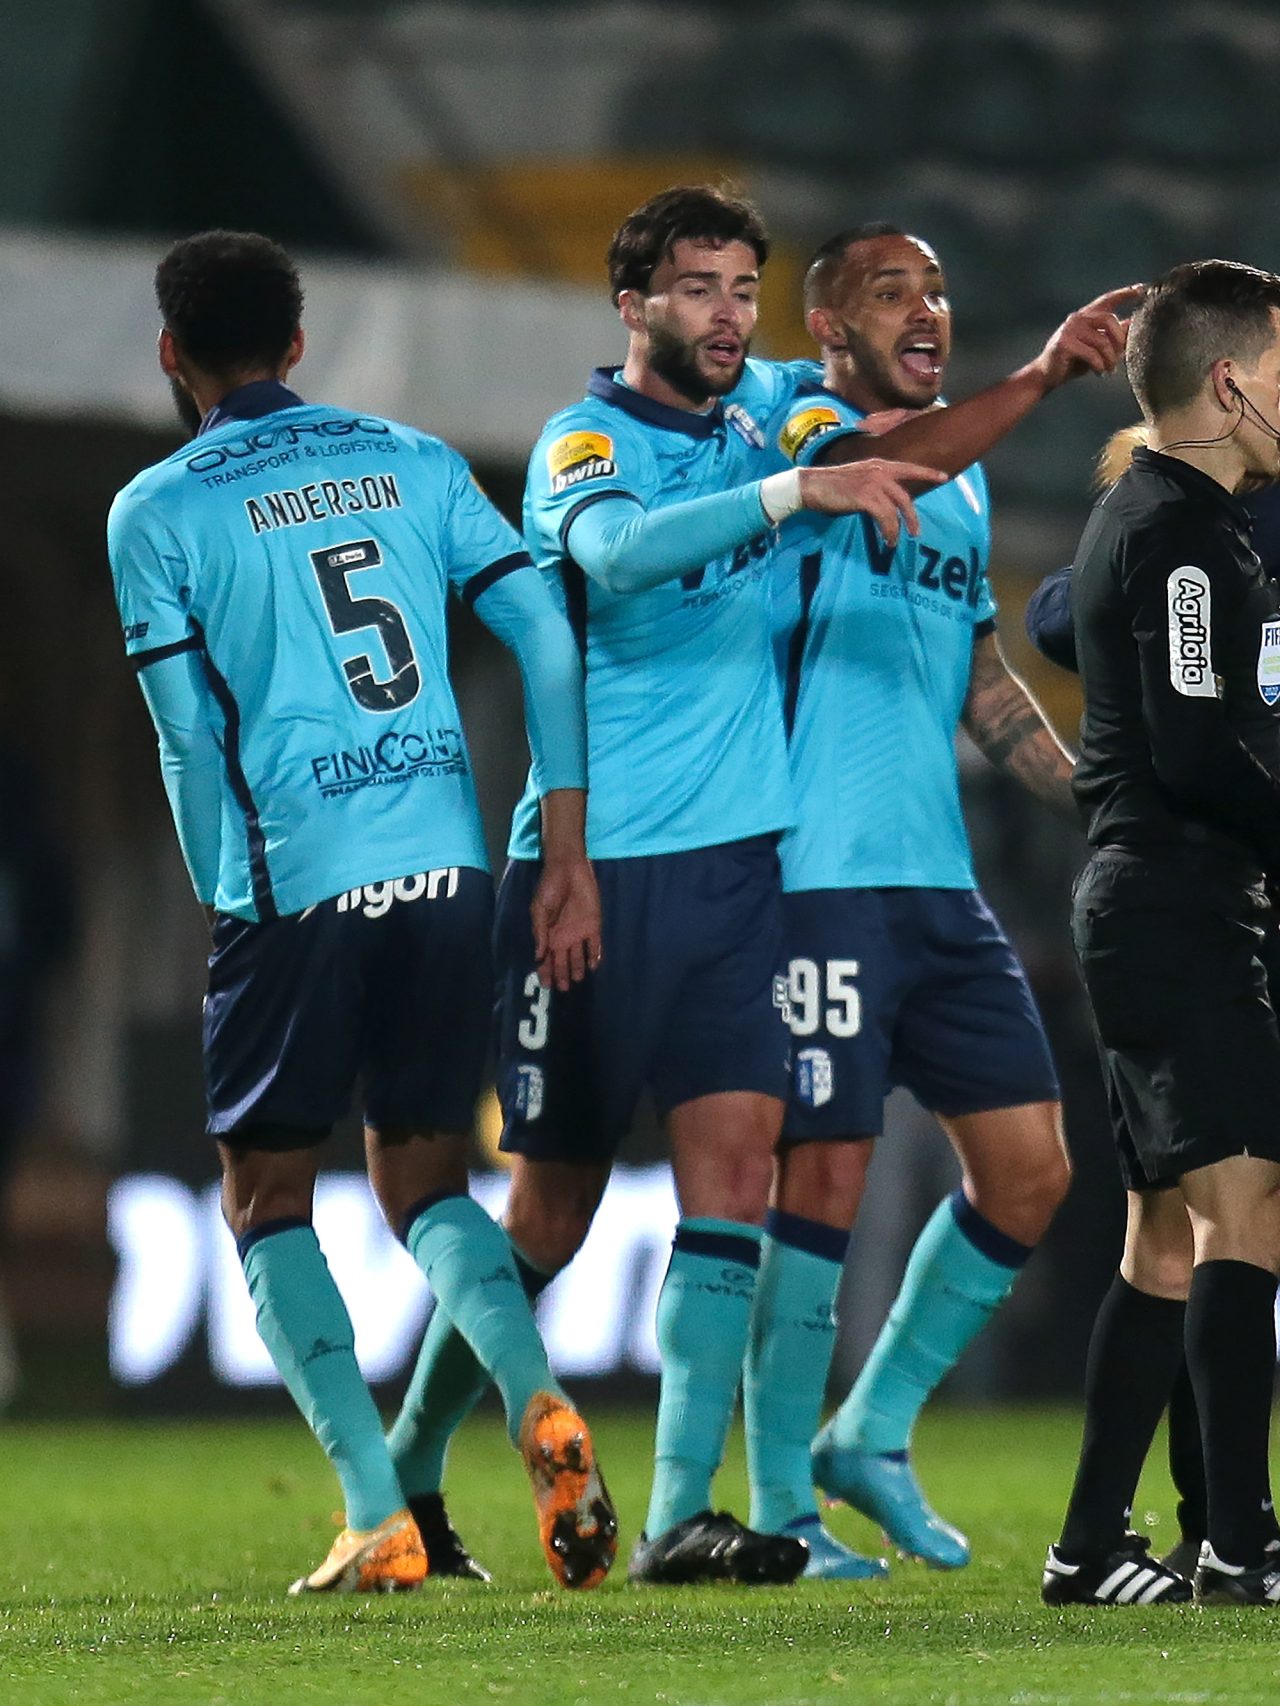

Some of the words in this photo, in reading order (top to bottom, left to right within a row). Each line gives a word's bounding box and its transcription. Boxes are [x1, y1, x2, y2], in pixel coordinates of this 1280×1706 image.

[200, 449, 301, 489] TRANSPORT
[305, 446, 317, 458] &
[321, 440, 399, 458] LOGISTICS
[245, 473, 402, 535] ANDERSON
[554, 458, 611, 493] bwin
[308, 537, 422, 714] 5
[1173, 578, 1208, 685] Agriloja
[518, 971, 550, 1050] 3
[788, 958, 861, 1037] 95
